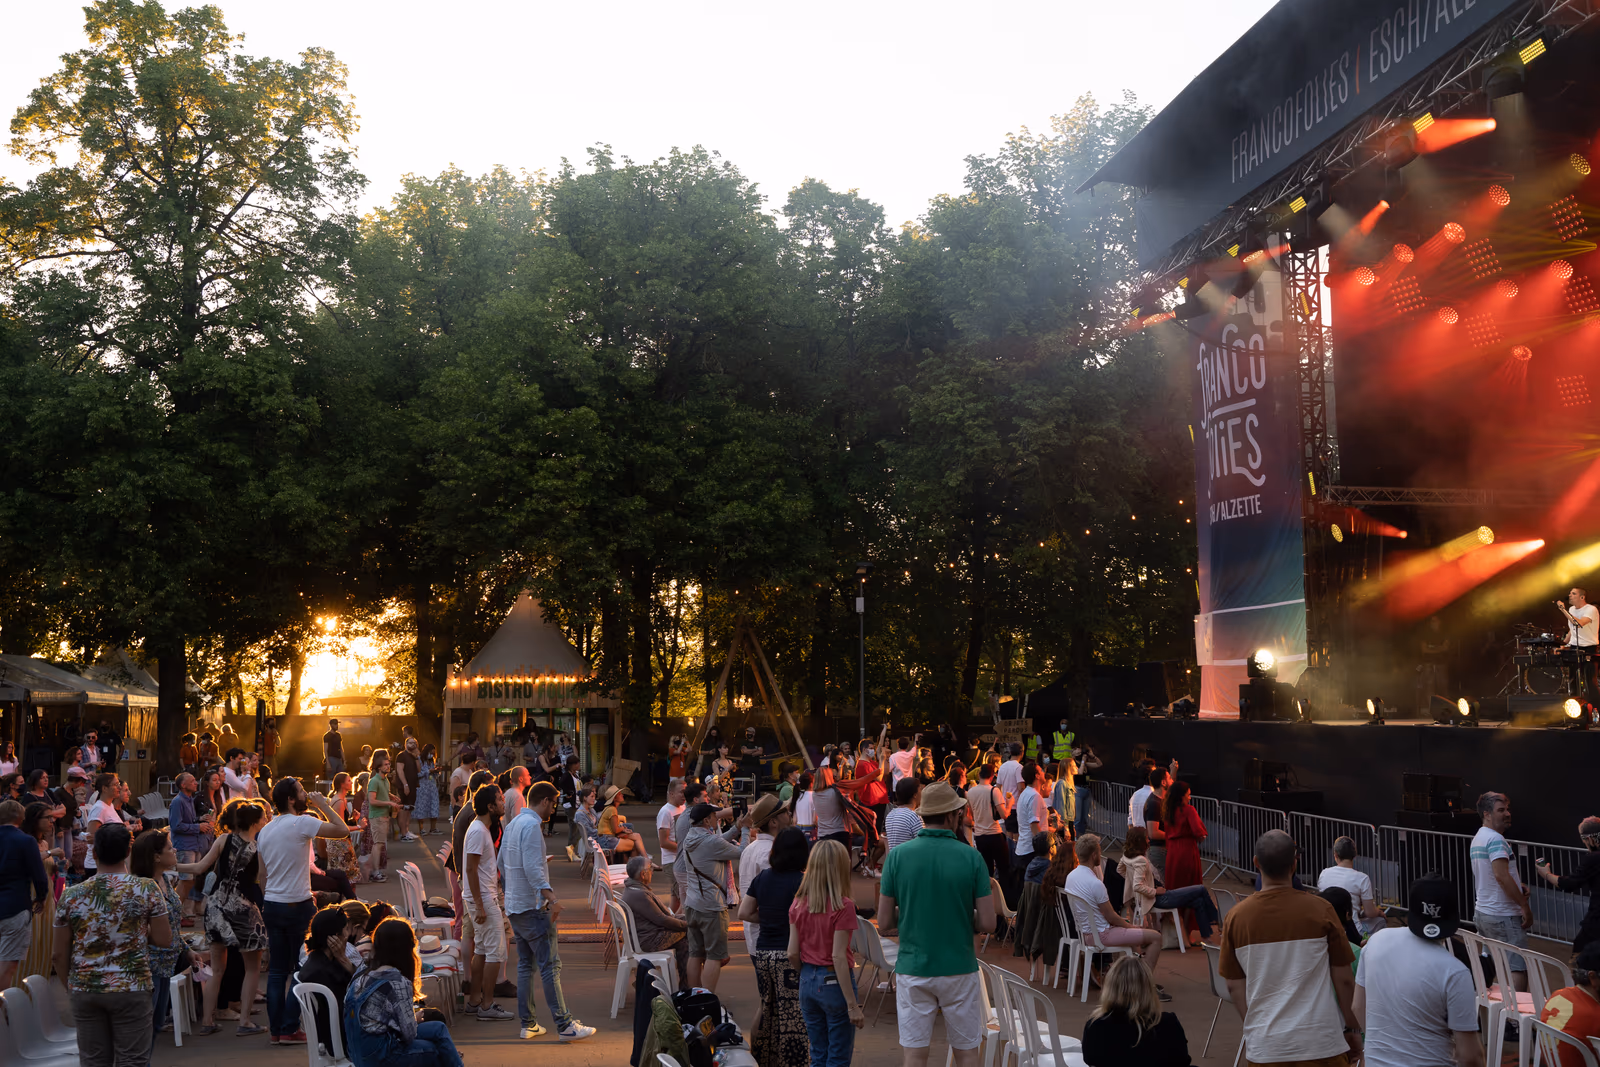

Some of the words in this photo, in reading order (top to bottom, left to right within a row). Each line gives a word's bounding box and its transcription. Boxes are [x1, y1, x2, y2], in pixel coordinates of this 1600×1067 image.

[1231, 51, 1349, 183] FRANCOFOLIES
[1369, 0, 1476, 83] ESCH/AL
[477, 681, 533, 699] BISTRO
[1421, 901, 1442, 919] NY
